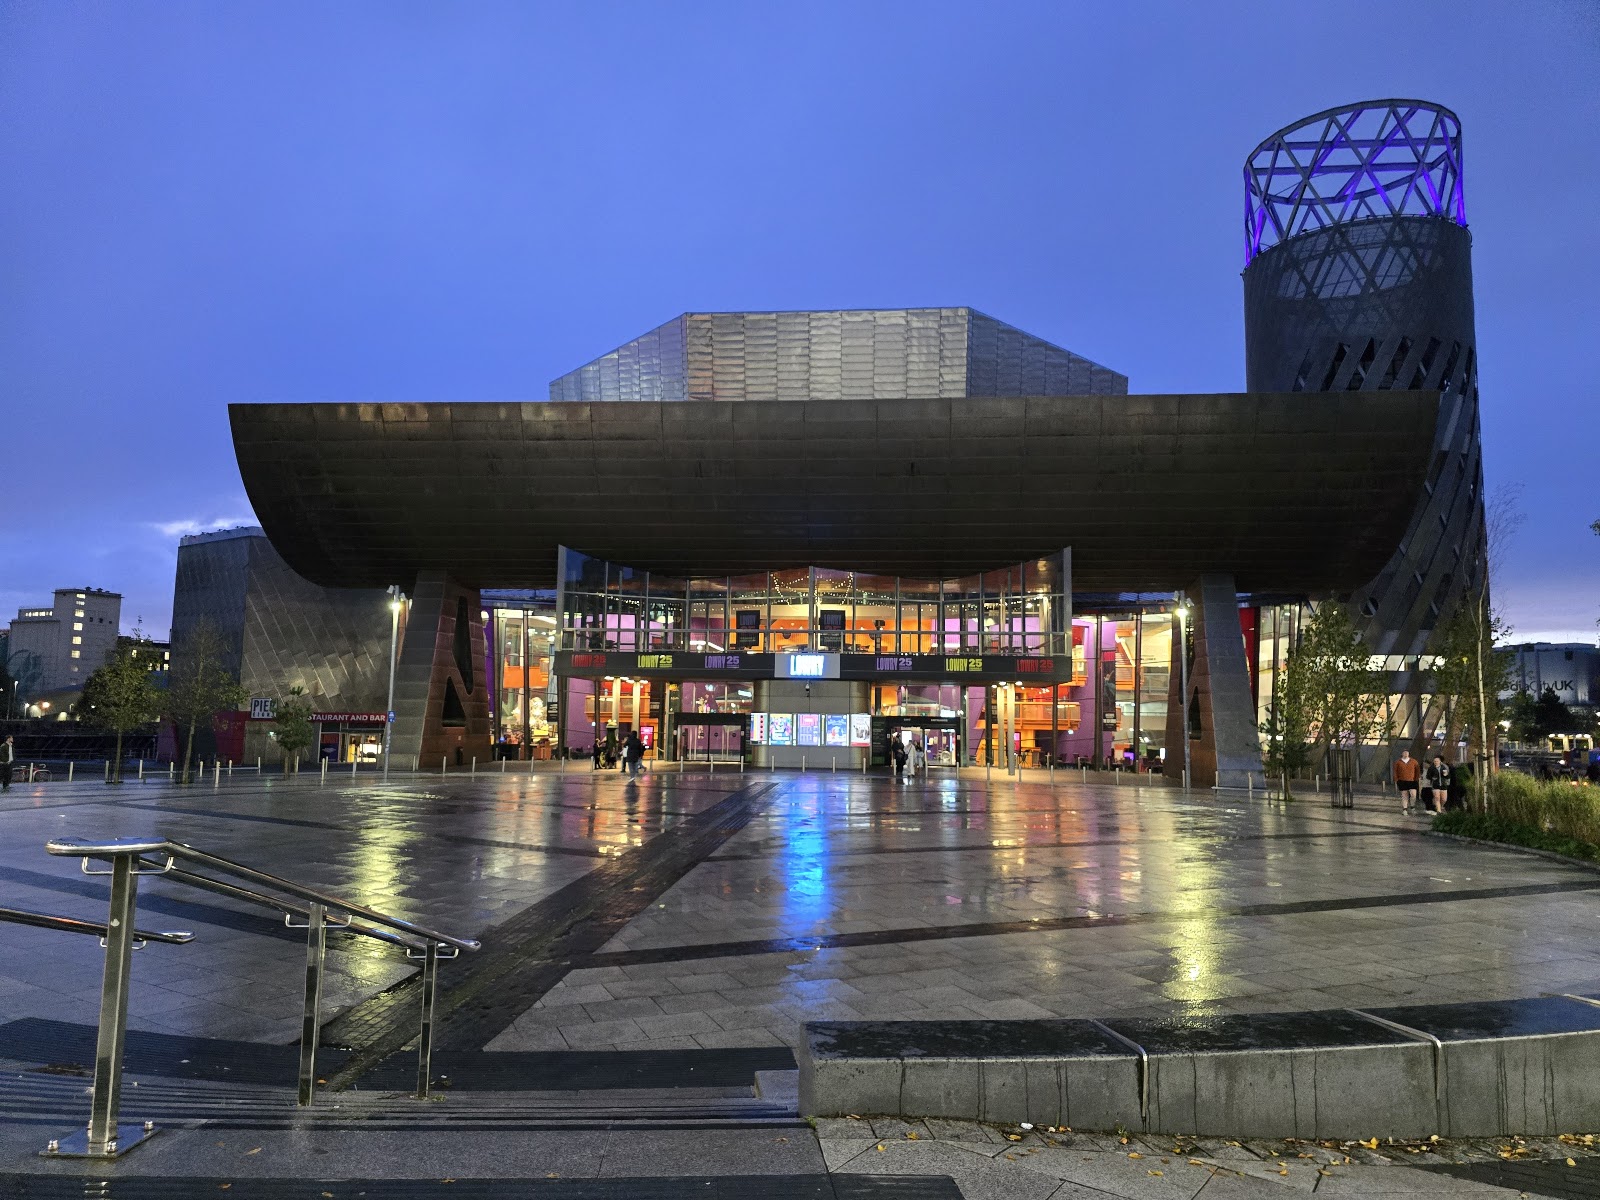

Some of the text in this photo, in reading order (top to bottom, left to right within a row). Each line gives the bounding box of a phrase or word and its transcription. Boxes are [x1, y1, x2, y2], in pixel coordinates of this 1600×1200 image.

[637, 655, 660, 668] LOWRY
[659, 655, 673, 663] 25
[704, 655, 740, 668] LOWRY 25
[790, 654, 824, 676] LOWRY
[876, 657, 898, 671] LOWRY
[898, 657, 912, 666] 25
[945, 658, 983, 672] LOWRY 25
[1016, 659, 1054, 672] LOWRY 25
[307, 713, 350, 721] STAURANT
